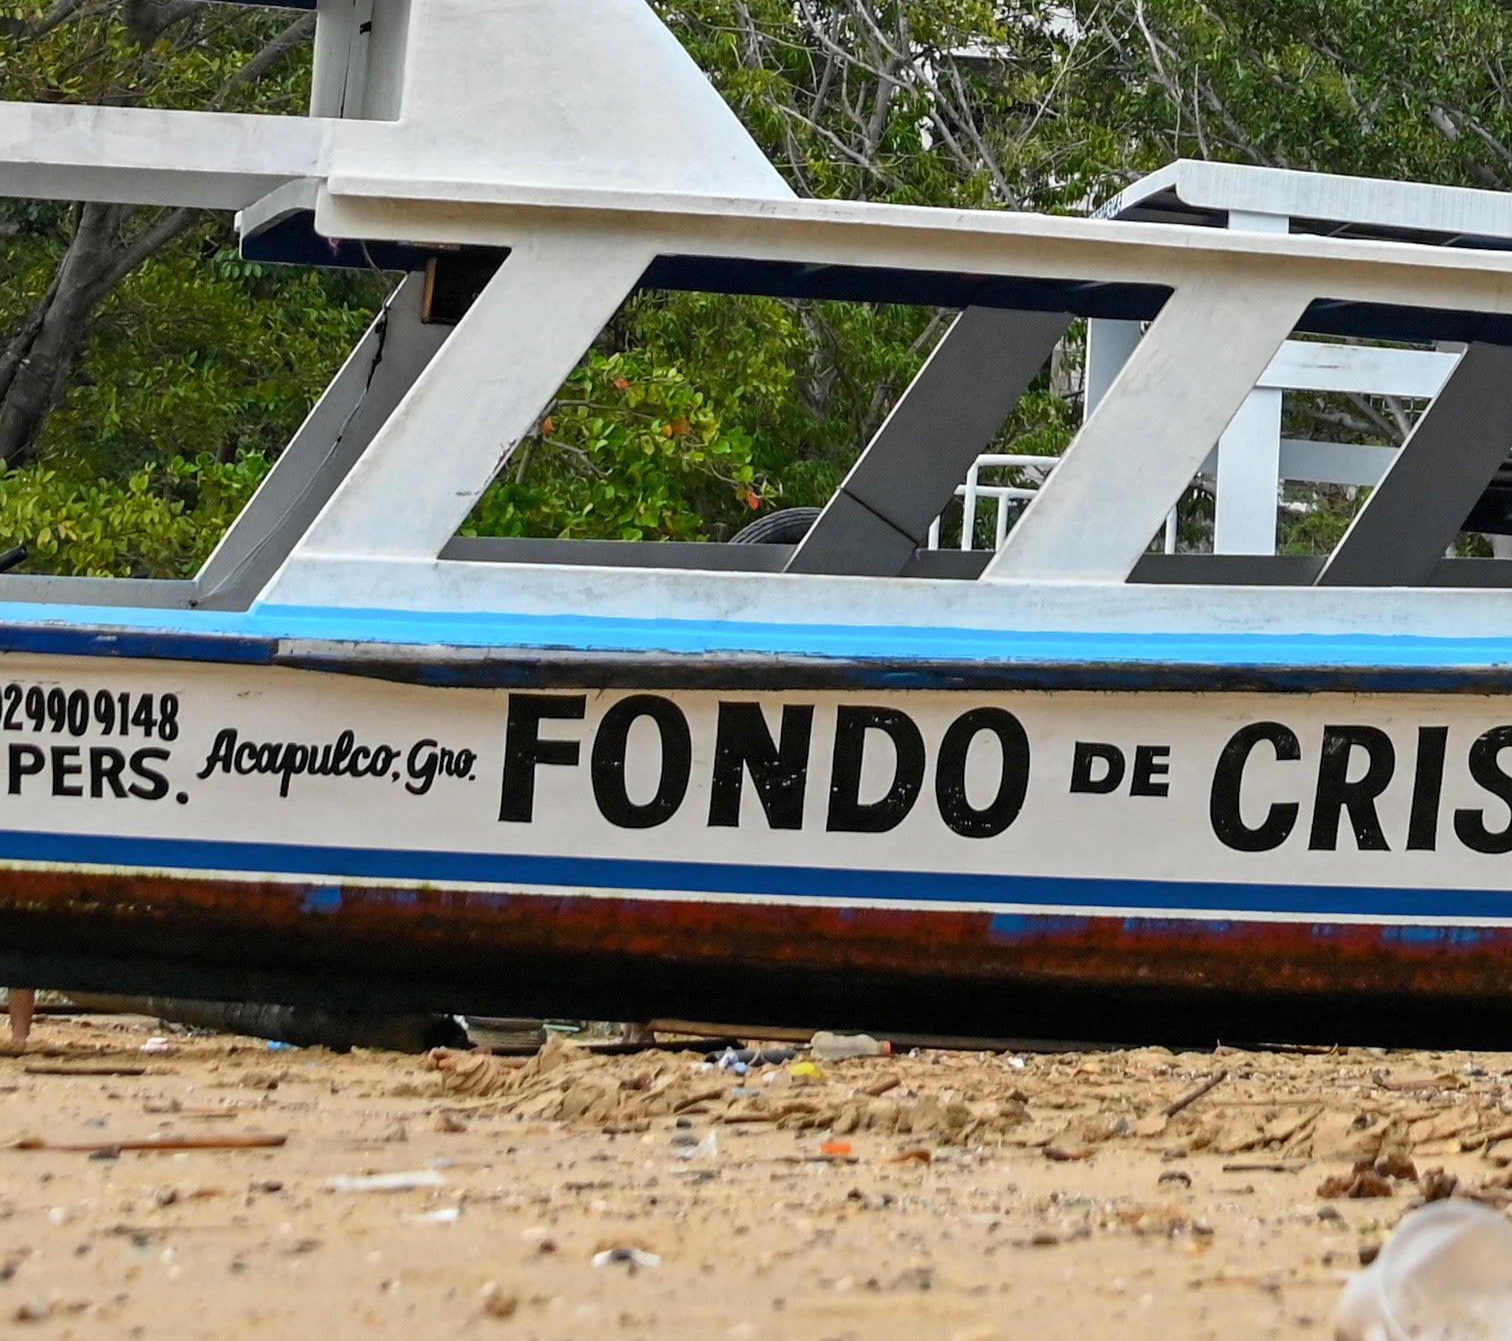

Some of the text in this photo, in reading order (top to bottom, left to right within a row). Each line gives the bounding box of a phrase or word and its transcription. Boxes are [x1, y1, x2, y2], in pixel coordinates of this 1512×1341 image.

[6, 742, 190, 805] PERS.
[498, 693, 1031, 839] FONDO
[1069, 741, 1171, 798] DE
